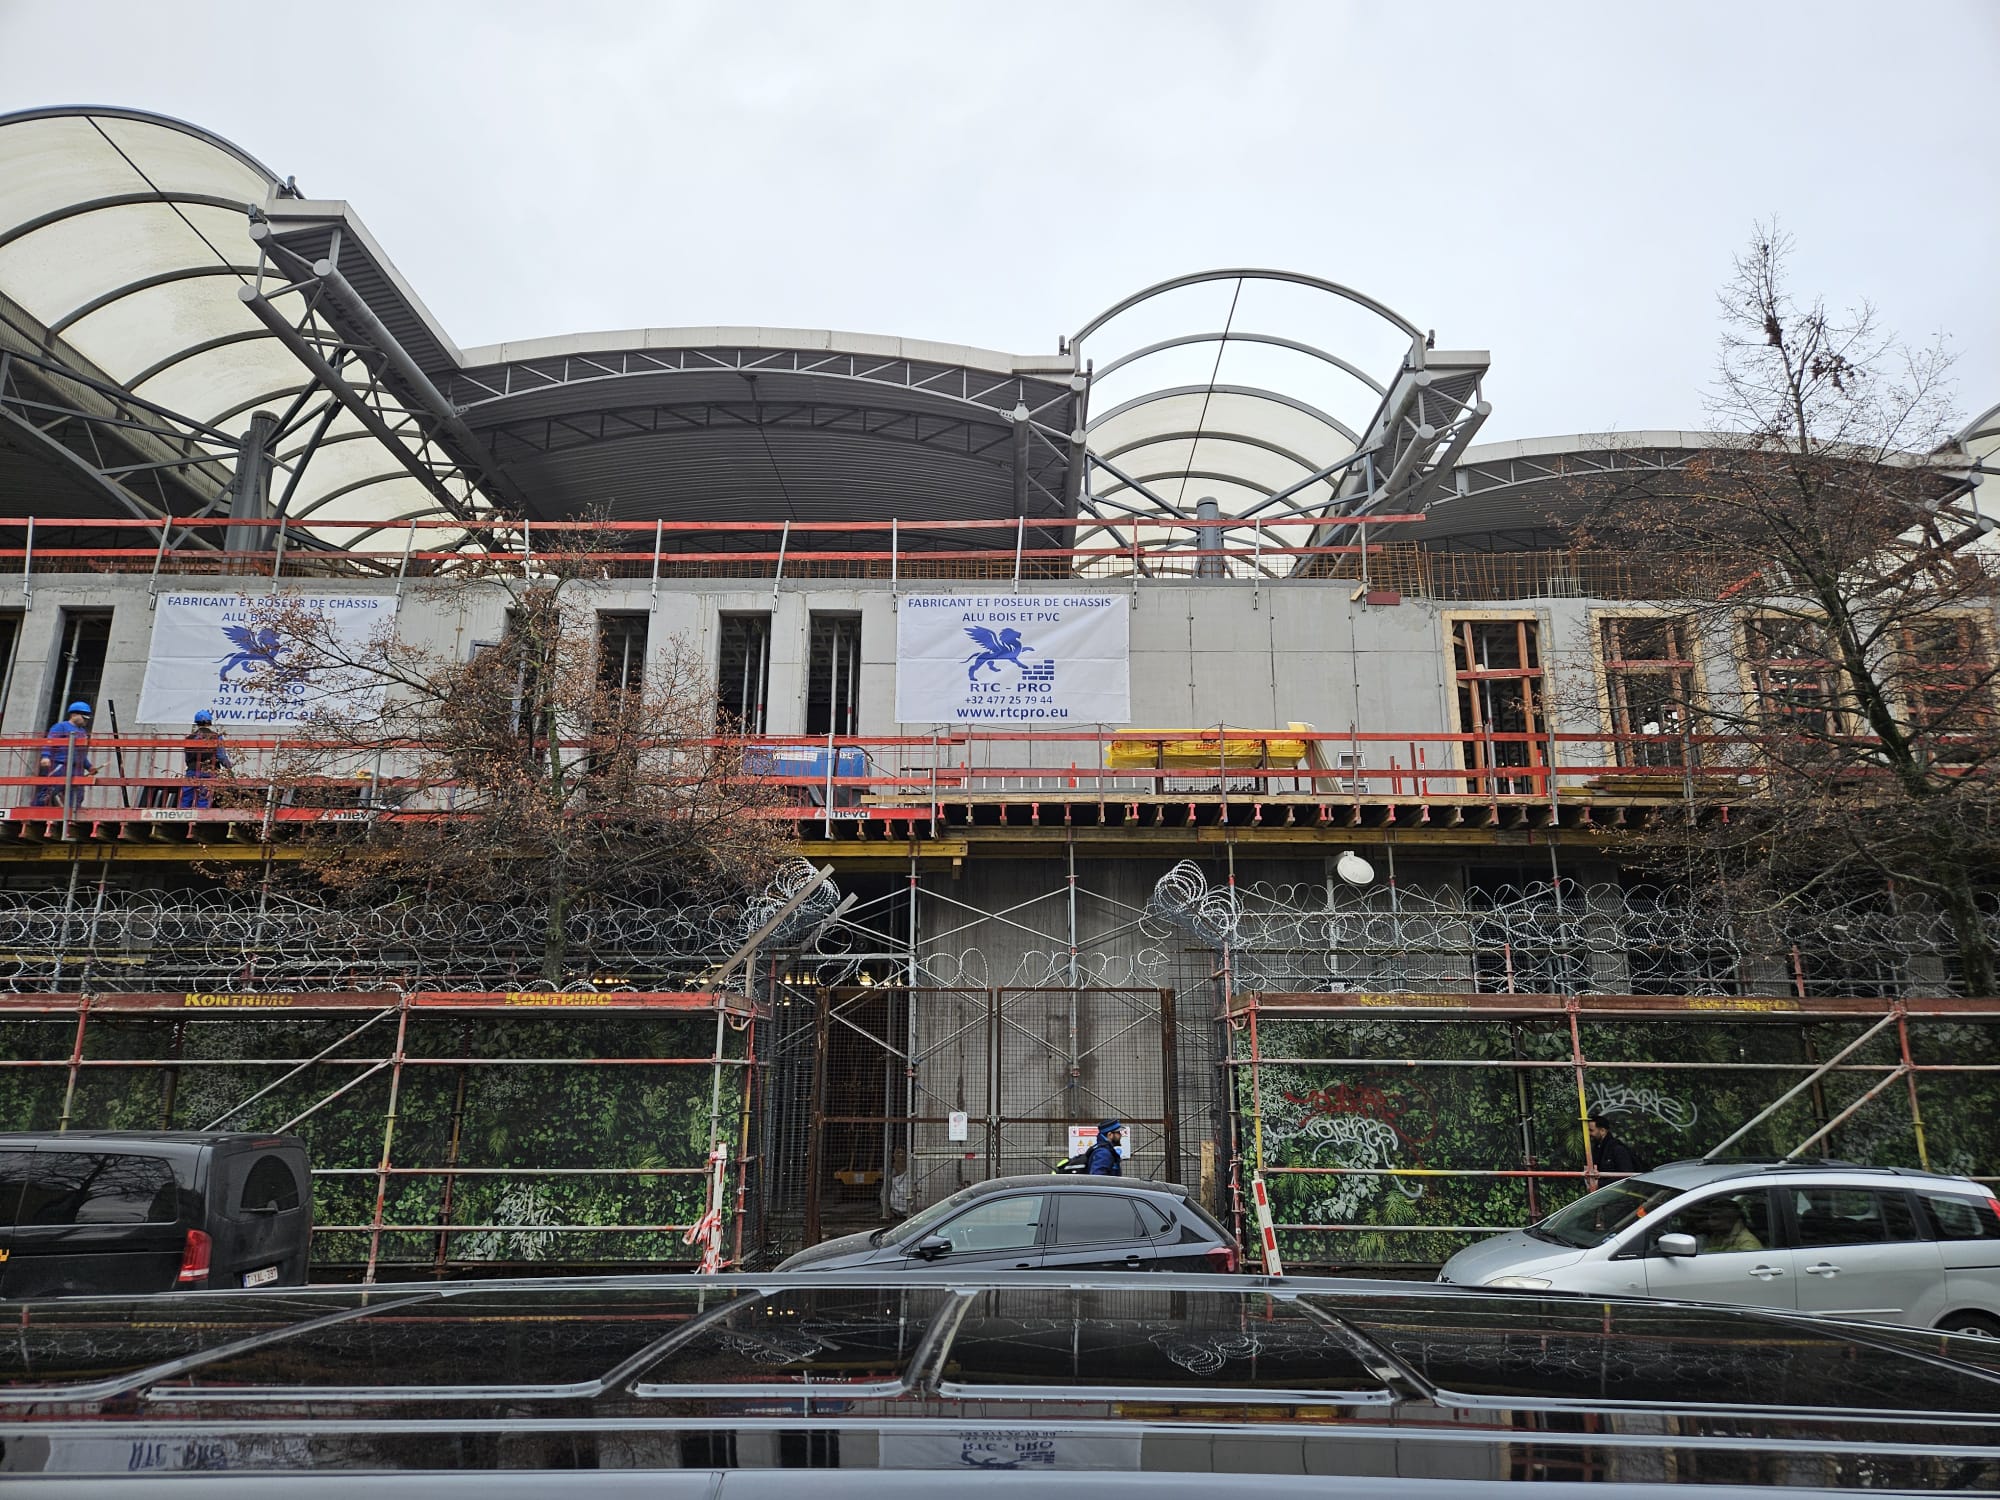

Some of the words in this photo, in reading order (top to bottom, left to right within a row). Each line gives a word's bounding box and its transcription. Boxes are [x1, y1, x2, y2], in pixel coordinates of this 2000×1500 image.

[168, 597, 237, 607] FABRICANT
[239, 598, 253, 607] ET
[309, 599, 325, 608] DE
[908, 598, 974, 608] FABRICANT
[977, 598, 989, 607] ET
[994, 598, 1041, 607] POSEUR
[1044, 598, 1060, 607] DE
[222, 612, 246, 622] ALU
[962, 612, 985, 622] ALU
[989, 612, 1017, 622] BOIS
[1020, 612, 1034, 622] ET
[1037, 612, 1061, 622] PVC
[219, 683, 252, 694] RTC
[970, 683, 1001, 693] RTC
[1017, 683, 1052, 693] PRO
[213, 696, 231, 706] +32
[234, 697, 255, 706] 477
[965, 695, 984, 705] +32
[986, 695, 1006, 705] 477
[1009, 695, 1021, 705] 25
[1025, 695, 1037, 705] 79
[1040, 695, 1053, 705] 44
[957, 707, 1068, 720] www.rtcpro.eu
[184, 993, 293, 1007] KONTRIMO
[504, 992, 612, 1006] KONTRIMO
